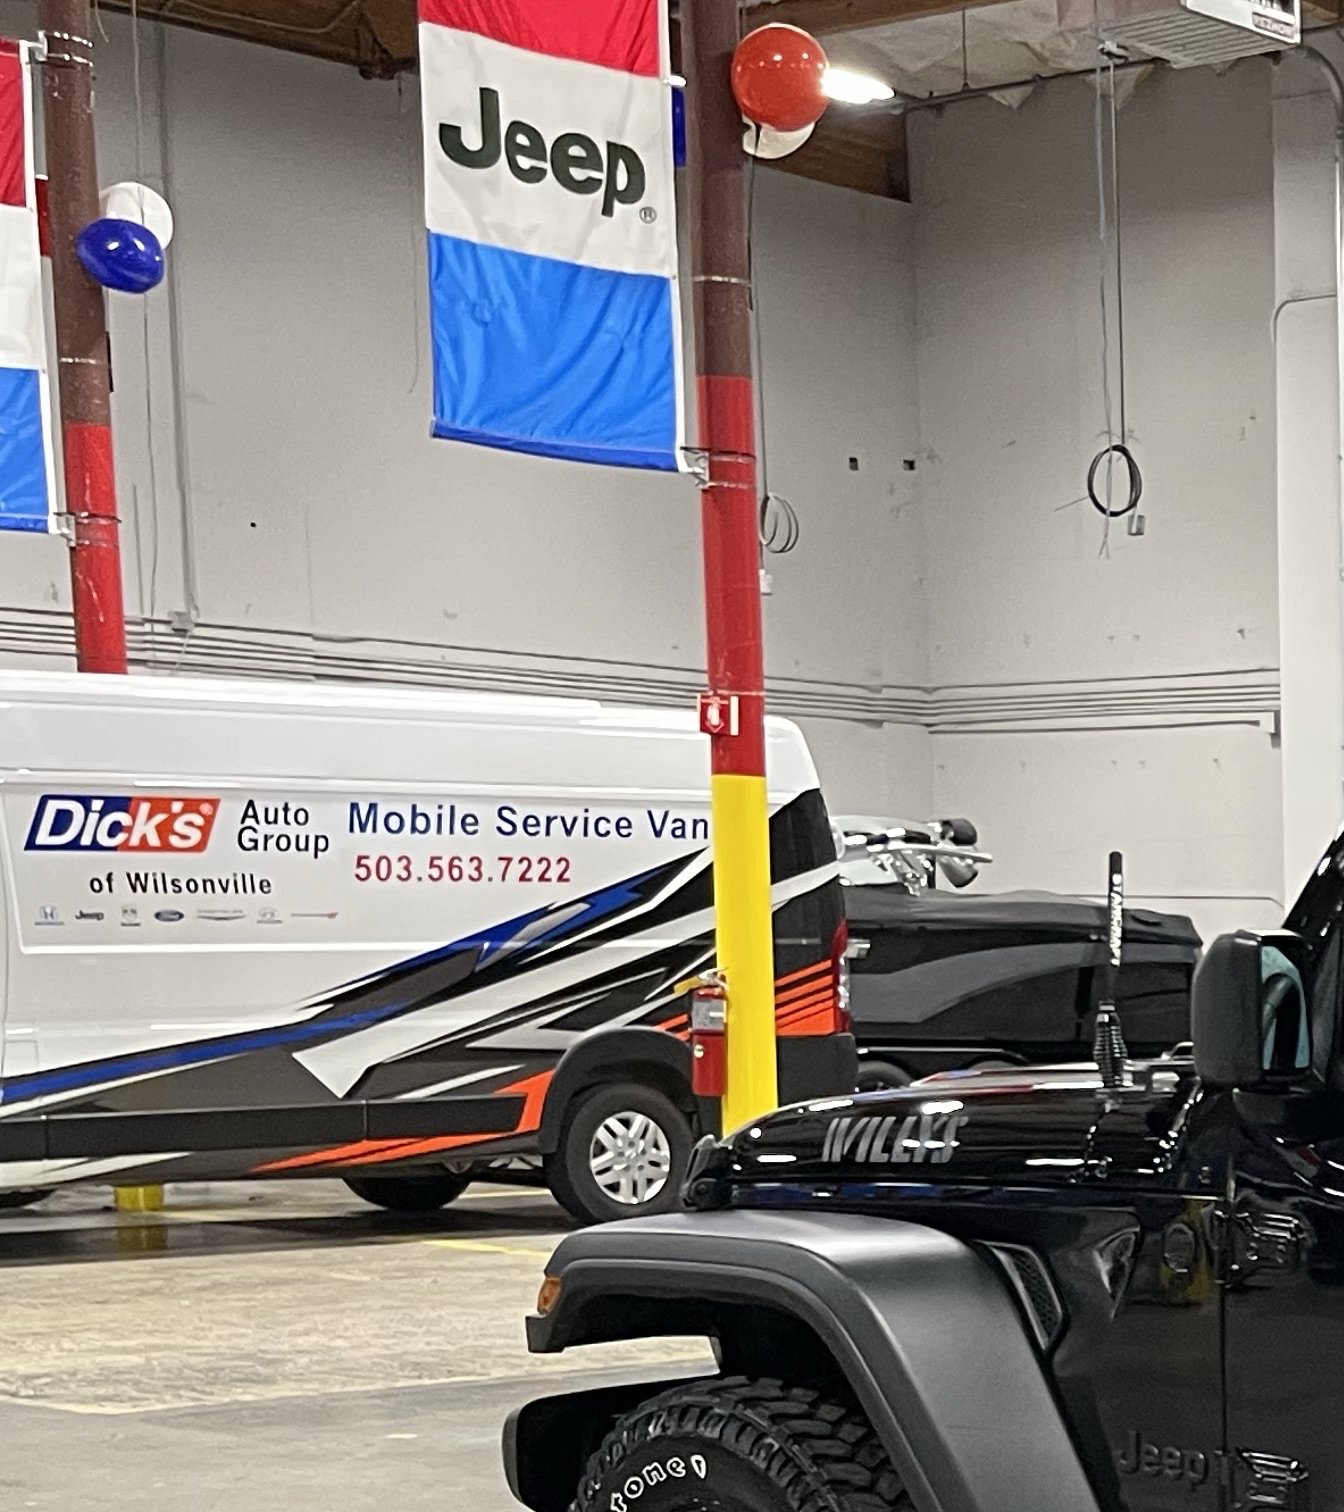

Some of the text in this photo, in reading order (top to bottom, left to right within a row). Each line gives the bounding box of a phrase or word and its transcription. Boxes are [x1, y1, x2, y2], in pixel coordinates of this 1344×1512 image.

[439, 86, 646, 217] Jeep
[240, 800, 310, 826] Auto
[349, 803, 709, 840] Mobile Service Van
[237, 826, 330, 859] Group
[89, 872, 272, 894] of Wilsonville
[355, 855, 572, 883] 503.563.7222
